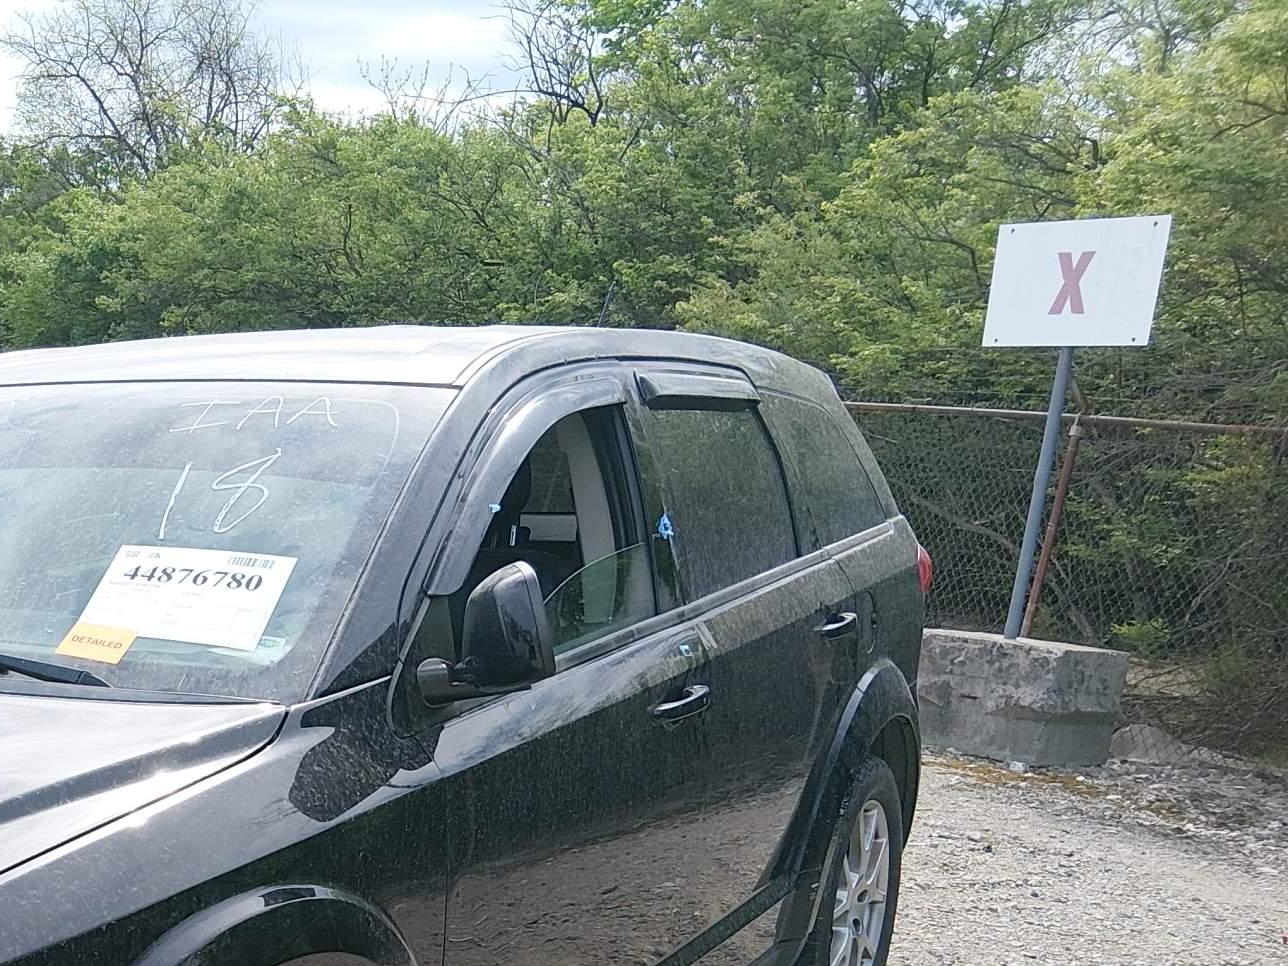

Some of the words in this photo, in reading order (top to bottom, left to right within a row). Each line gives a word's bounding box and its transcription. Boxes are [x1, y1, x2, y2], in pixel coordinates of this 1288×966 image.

[1048, 251, 1097, 315] X
[169, 396, 340, 433] IAA
[159, 448, 281, 539] 18
[123, 565, 263, 591] 44876780
[71, 635, 123, 649] DETAILED
